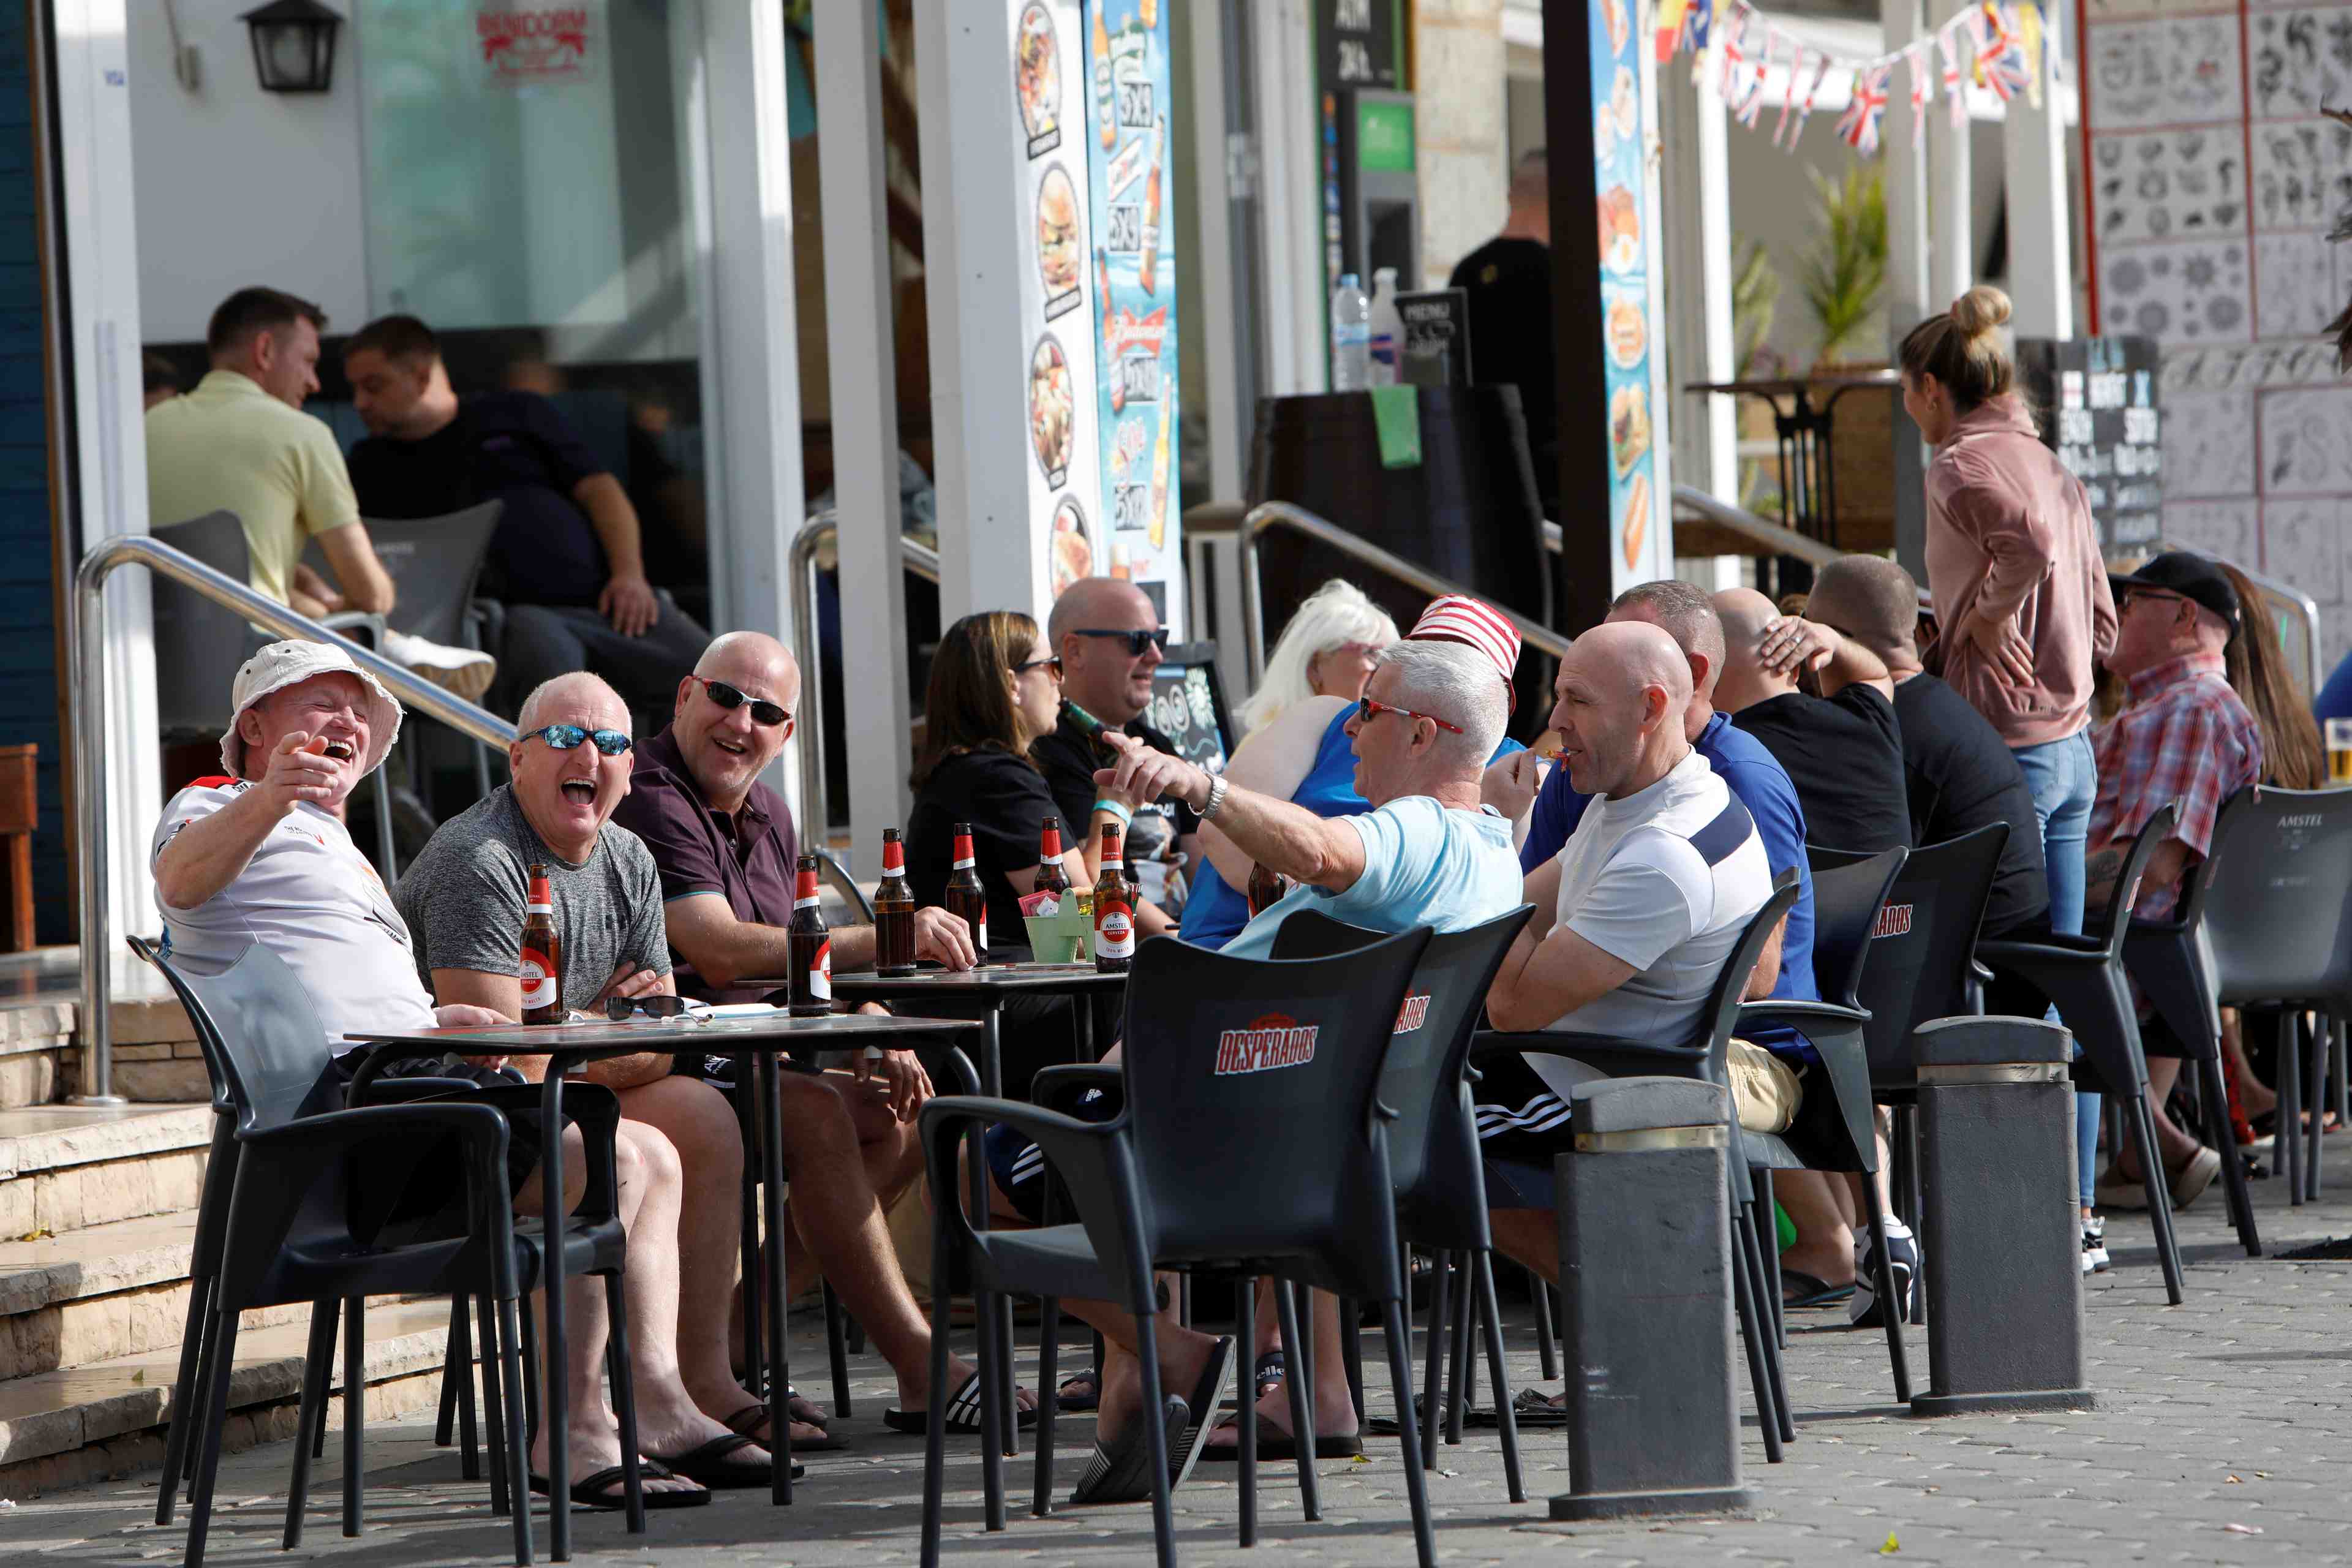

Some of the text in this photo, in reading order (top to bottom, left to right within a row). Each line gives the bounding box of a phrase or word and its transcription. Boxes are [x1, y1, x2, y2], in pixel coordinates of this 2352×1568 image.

[1404, 302, 1451, 321] MENU
[2278, 814, 2323, 828] AMSTEL
[1215, 1025, 1319, 1075] DESPERADOS
[1256, 1365, 1284, 1380] elle
